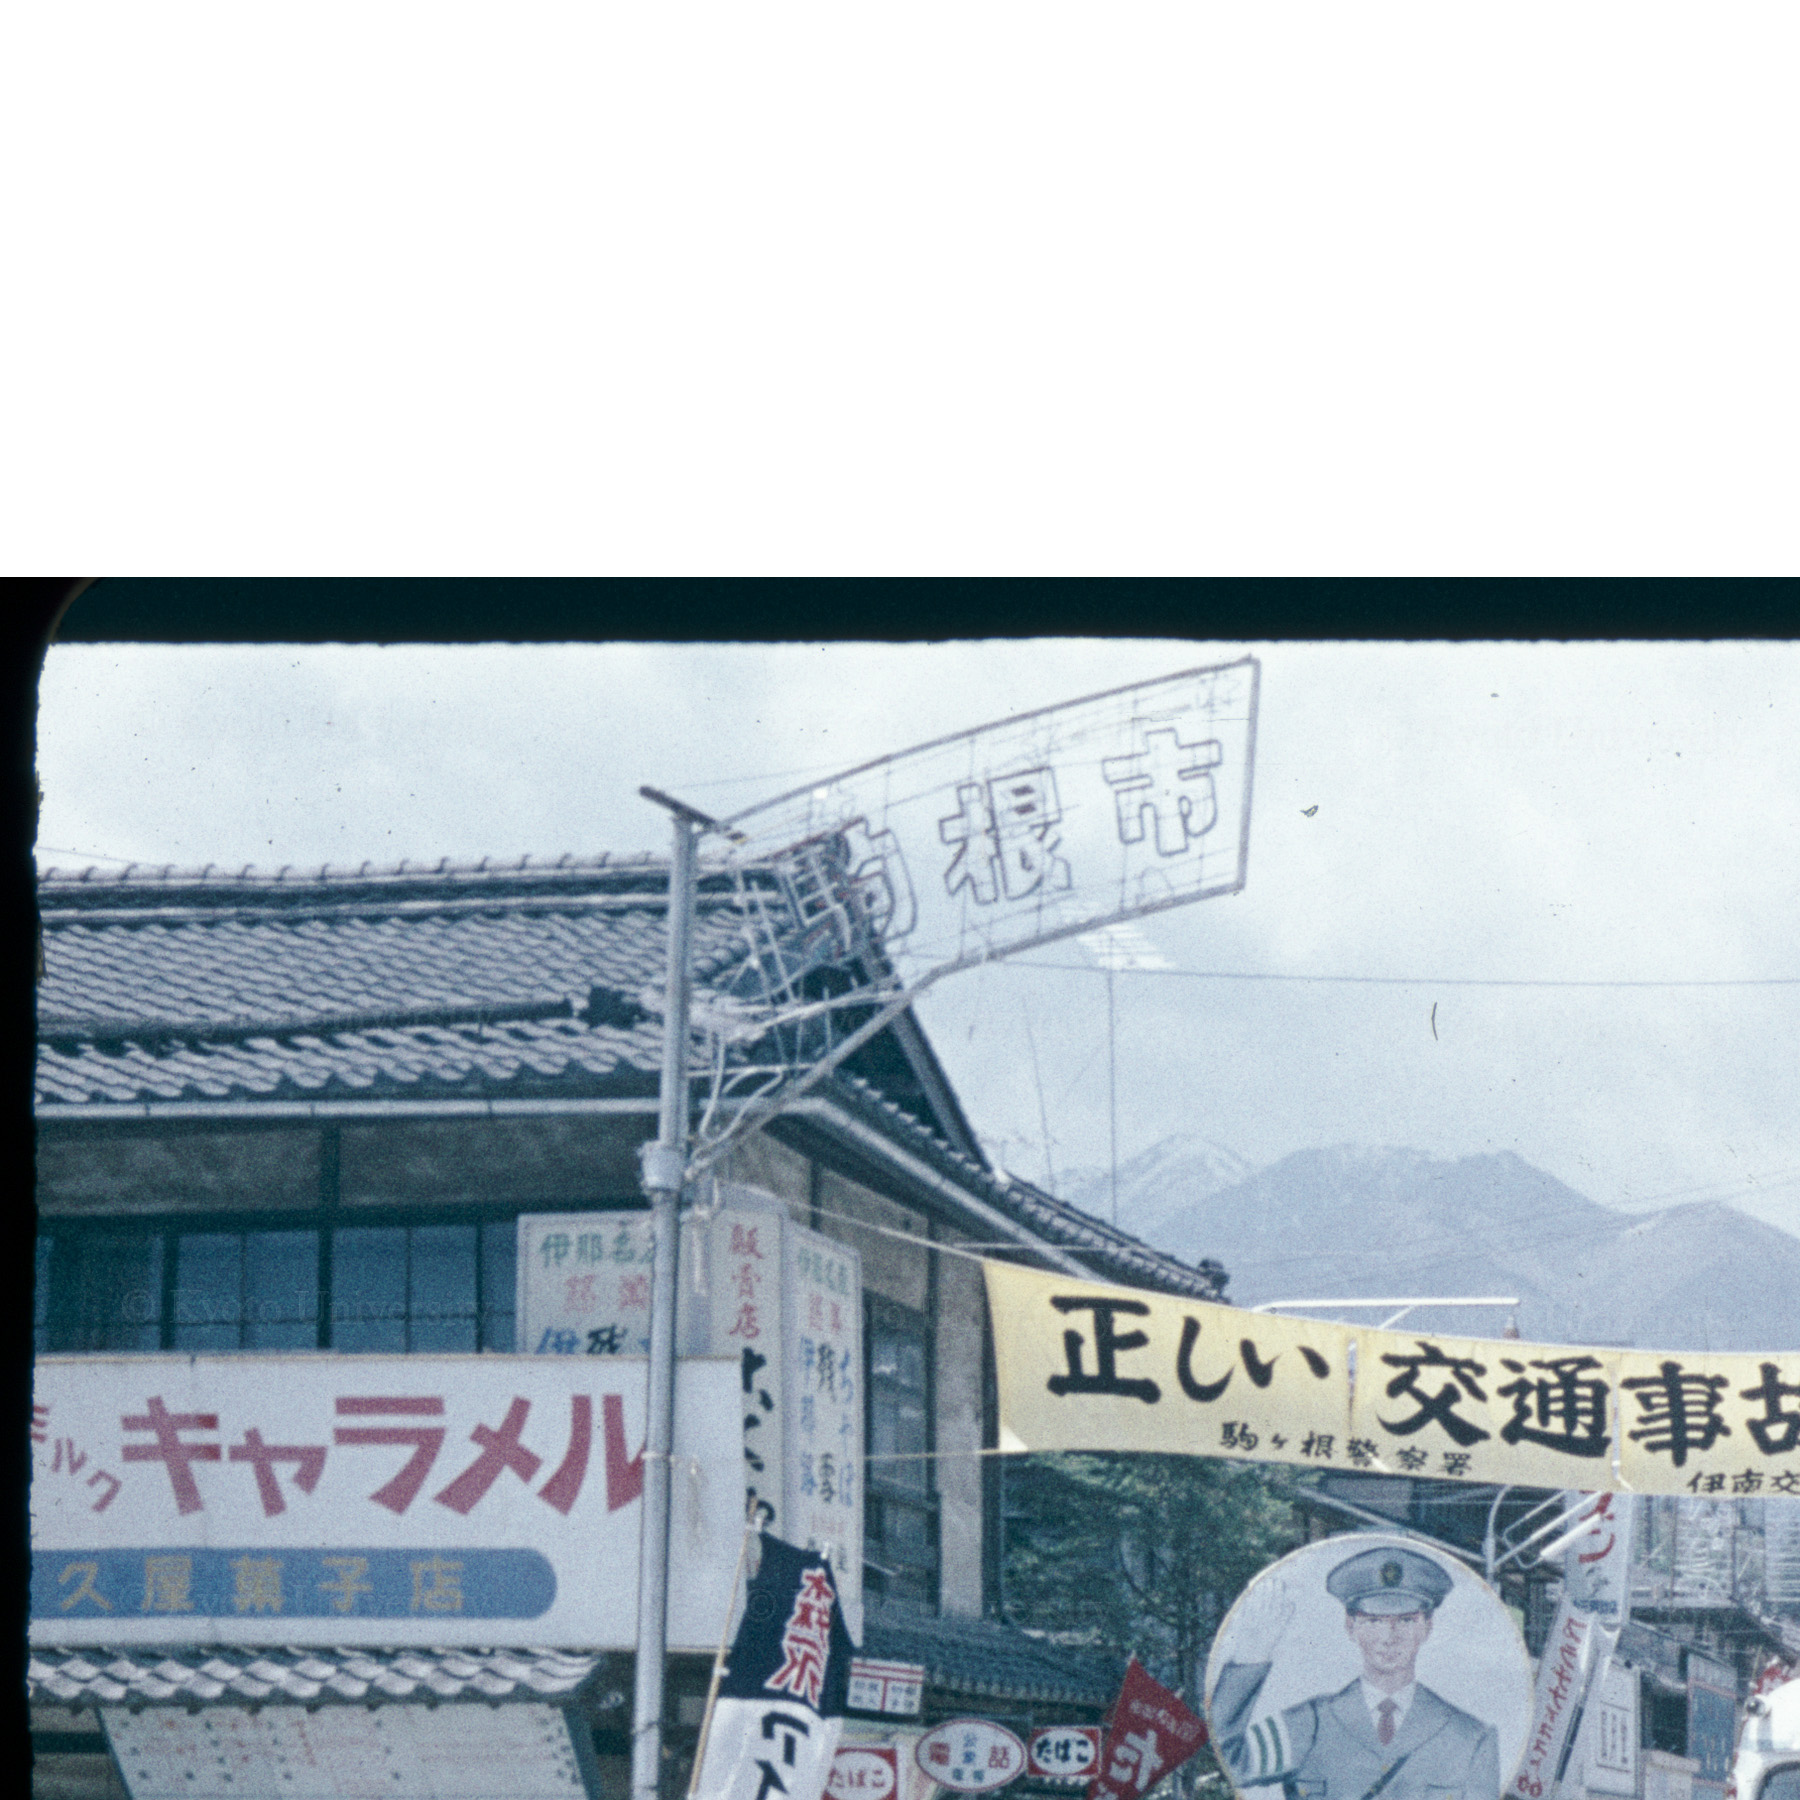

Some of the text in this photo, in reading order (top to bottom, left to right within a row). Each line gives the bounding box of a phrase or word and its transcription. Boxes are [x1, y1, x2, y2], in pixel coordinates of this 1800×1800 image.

[1047, 1295, 1329, 1404] 正しい
[121, 1392, 643, 1516] キャラメル
[1036, 1738, 1089, 1765] たばこ
